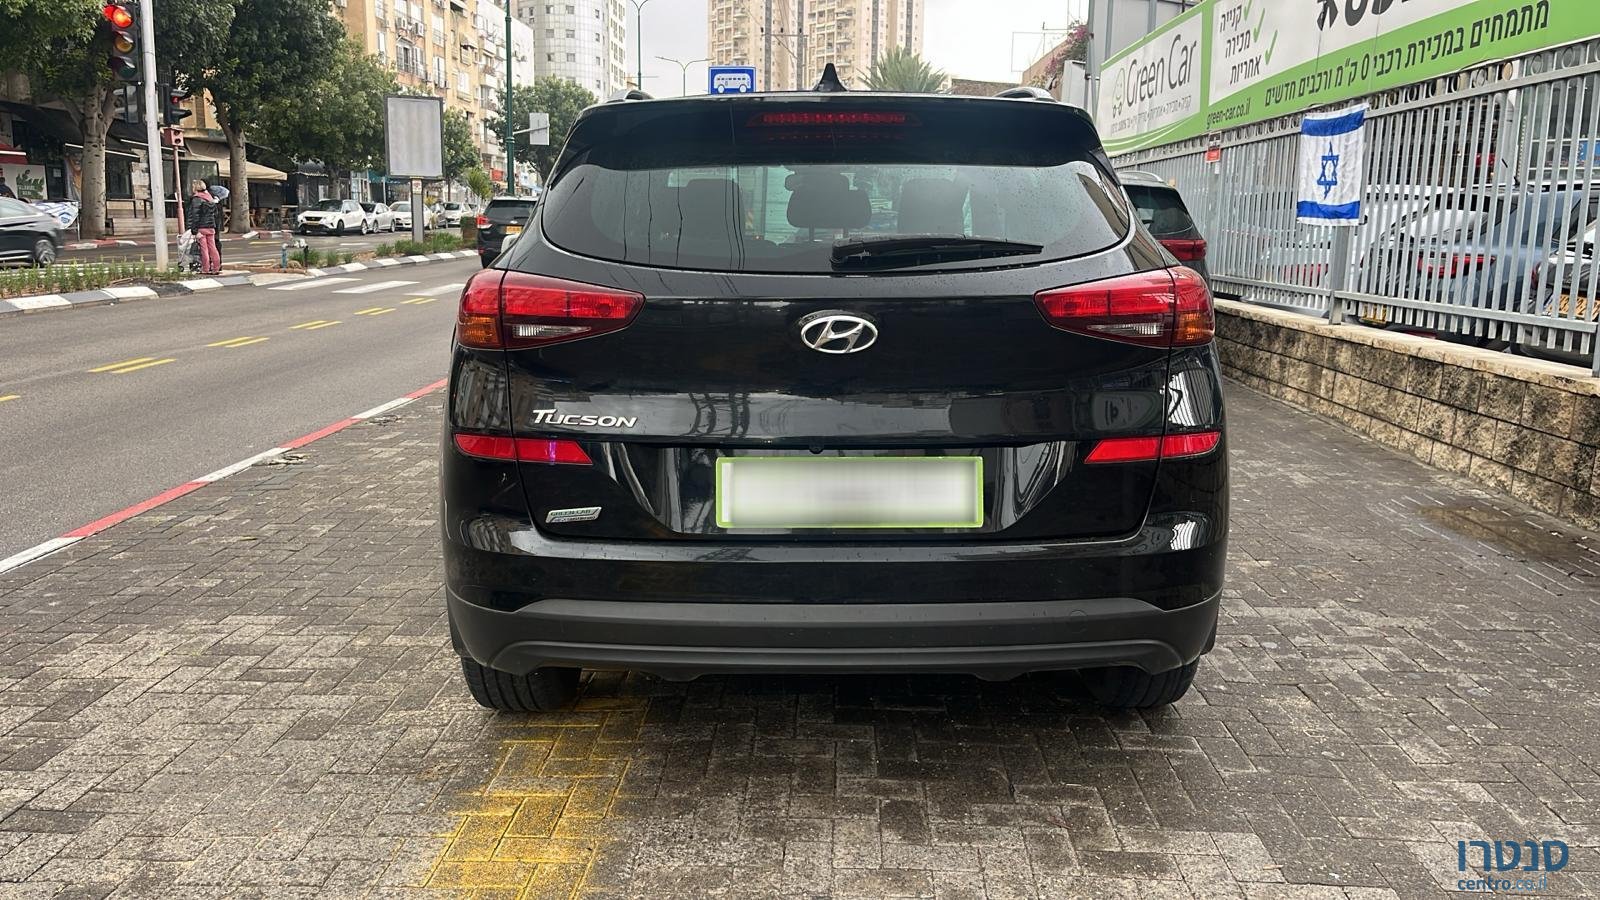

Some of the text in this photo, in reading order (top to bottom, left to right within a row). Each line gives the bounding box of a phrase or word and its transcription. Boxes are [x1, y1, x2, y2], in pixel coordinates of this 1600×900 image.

[1219, 5, 1242, 33] קנייה
[1470, 0, 1549, 48] מתמחים
[1225, 29, 1251, 58] מכירה
[1405, 27, 1464, 68] במכירת
[1126, 33, 1197, 107] Green Car
[1229, 55, 1262, 86] אחריות
[1361, 53, 1370, 81] 0
[1373, 47, 1402, 77] רכבי
[1264, 80, 1297, 107] חדשים
[1299, 68, 1332, 97] ורכבים
[1206, 97, 1252, 130] green-car.co.il
